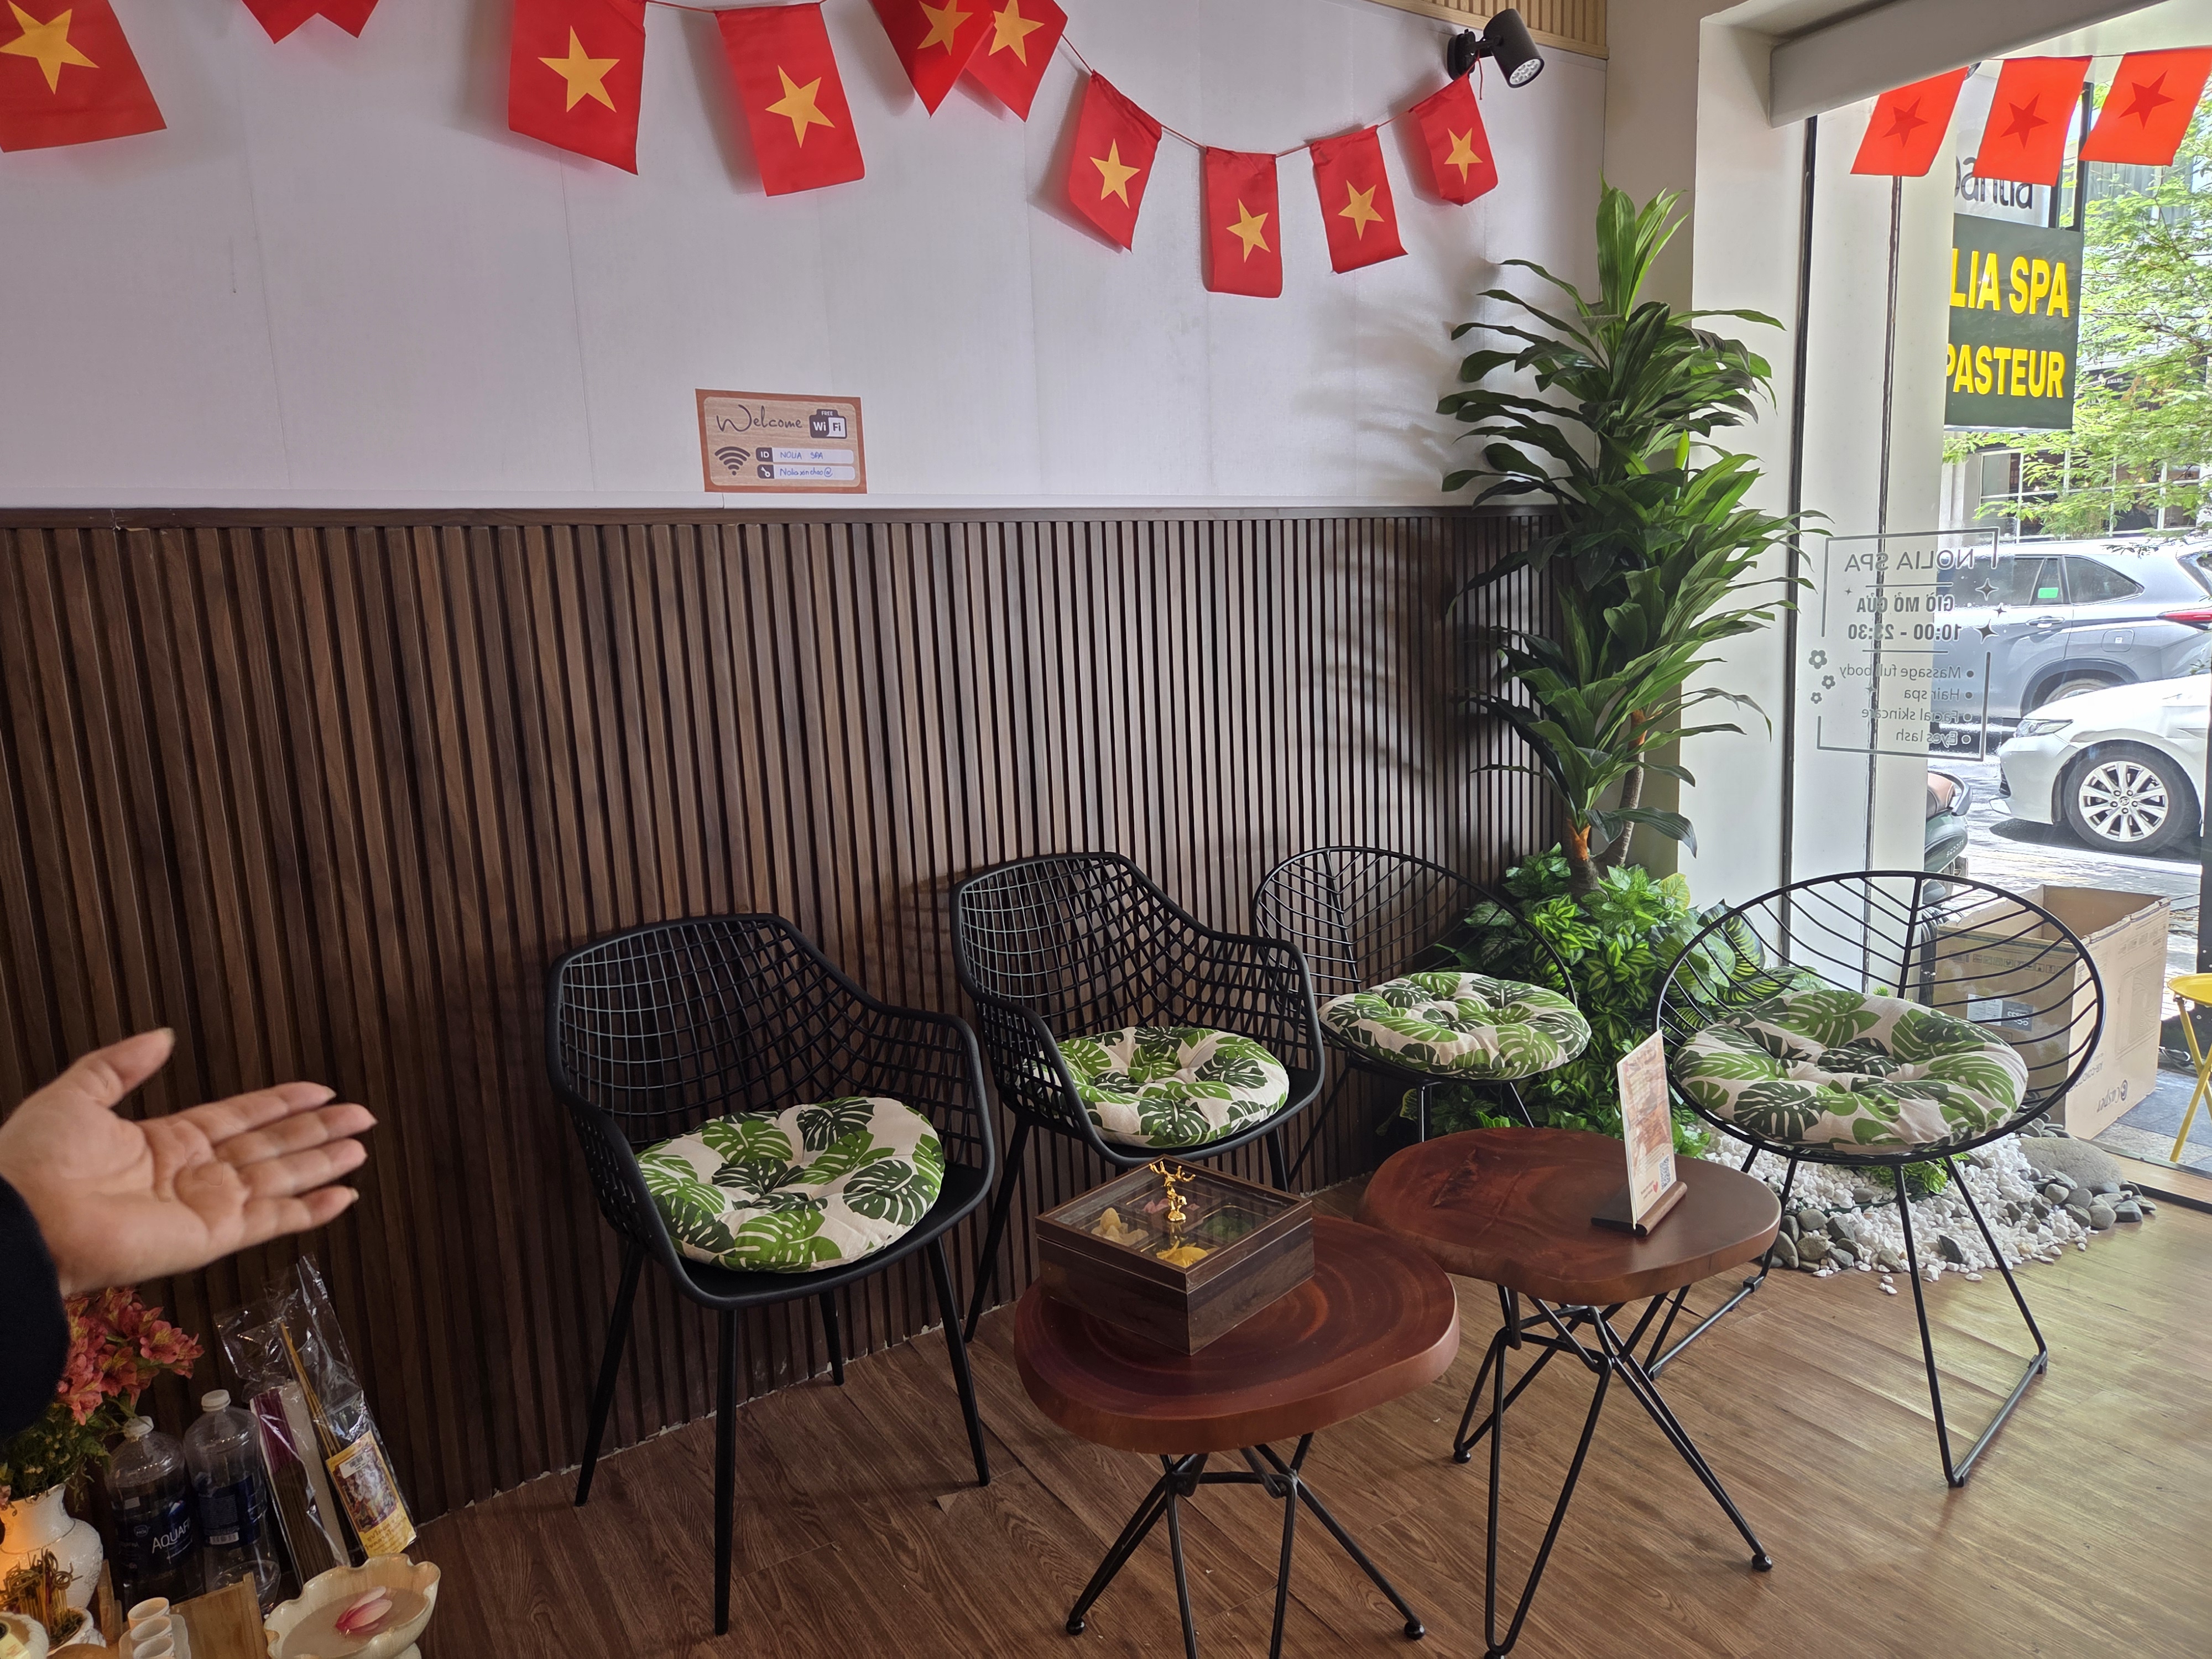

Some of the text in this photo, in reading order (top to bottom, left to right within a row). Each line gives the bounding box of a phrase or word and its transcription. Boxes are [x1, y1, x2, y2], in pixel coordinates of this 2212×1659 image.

[1949, 248, 2069, 318] LIA SPA
[716, 404, 802, 432] Welcome
[2096, 1087, 2120, 1113] Casper
